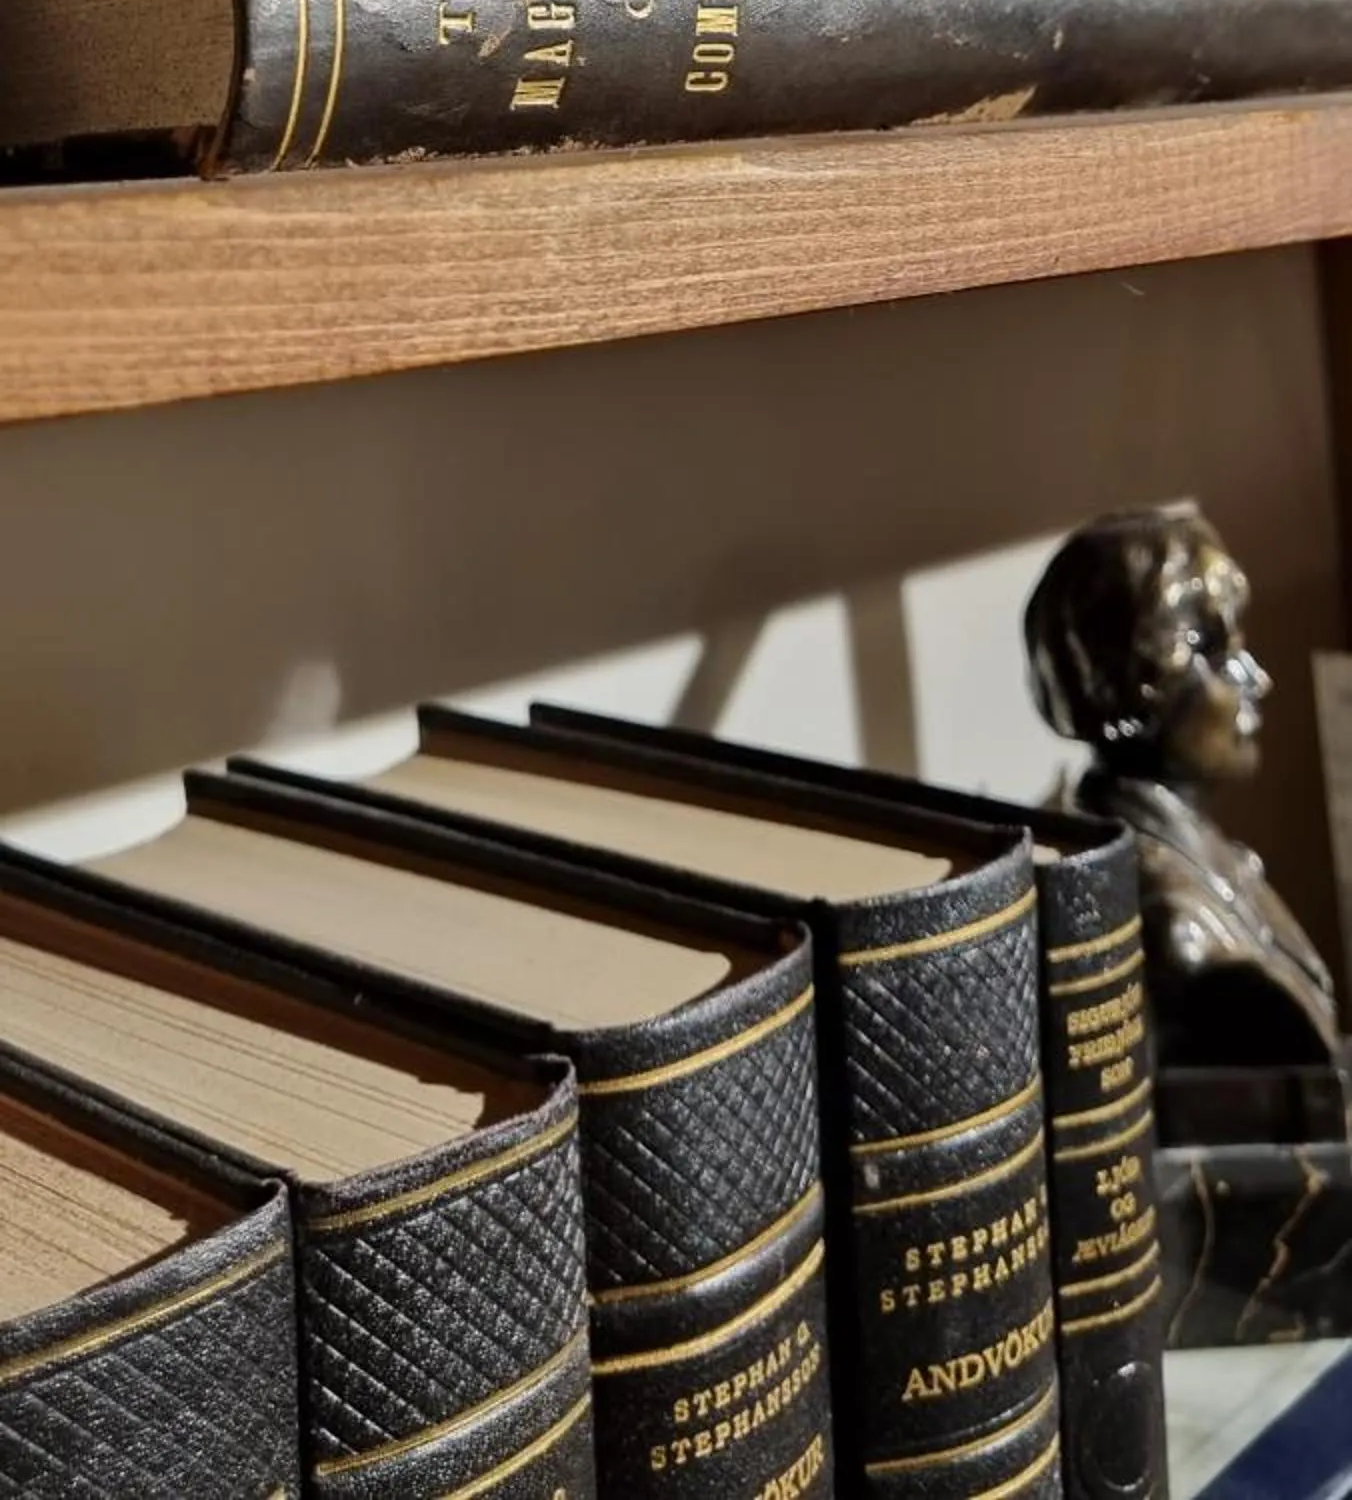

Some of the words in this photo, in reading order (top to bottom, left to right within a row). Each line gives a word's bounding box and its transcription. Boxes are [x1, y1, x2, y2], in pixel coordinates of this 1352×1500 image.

[904, 1197, 1038, 1272] STEPHAN
[650, 1341, 821, 1471] STEPHANSSON
[673, 1337, 791, 1424] STEPHAN
